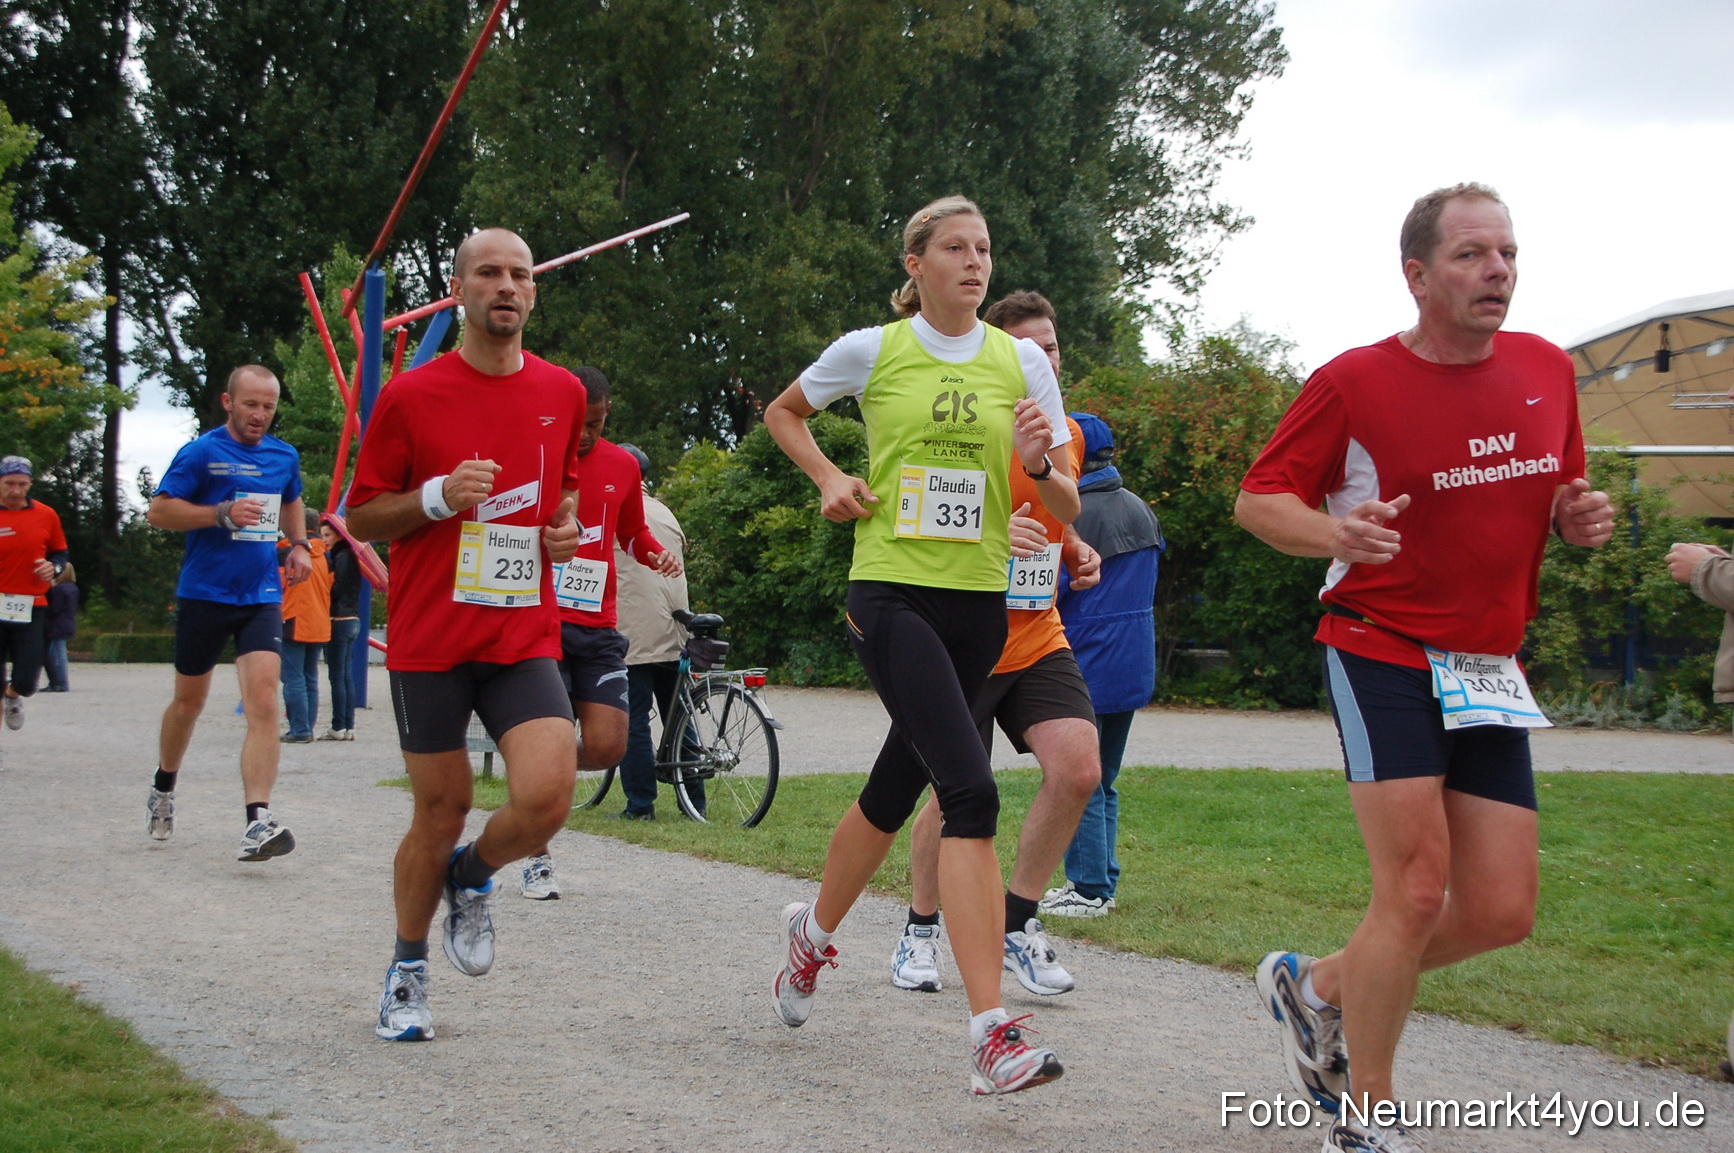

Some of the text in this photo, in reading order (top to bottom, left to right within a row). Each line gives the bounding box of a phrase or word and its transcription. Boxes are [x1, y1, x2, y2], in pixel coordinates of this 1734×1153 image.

[932, 390, 978, 424] CIS
[931, 439, 985, 451] INTERSPORT
[933, 448, 975, 459] LANGE
[1468, 432, 1516, 458] DAV
[1432, 453, 1560, 491] Röthenbach
[929, 475, 976, 494] Claudia
[495, 493, 524, 511] DEHN
[901, 498, 909, 511] B
[260, 512, 277, 524] 642
[935, 503, 981, 529] 331
[488, 531, 531, 549] Helmut
[462, 552, 470, 564] C
[494, 557, 534, 580] 233
[567, 562, 594, 574] Andrew
[564, 576, 599, 593] 2377
[1016, 569, 1054, 586] 3150
[6, 601, 26, 612] 512
[1463, 678, 1523, 700] 3042
